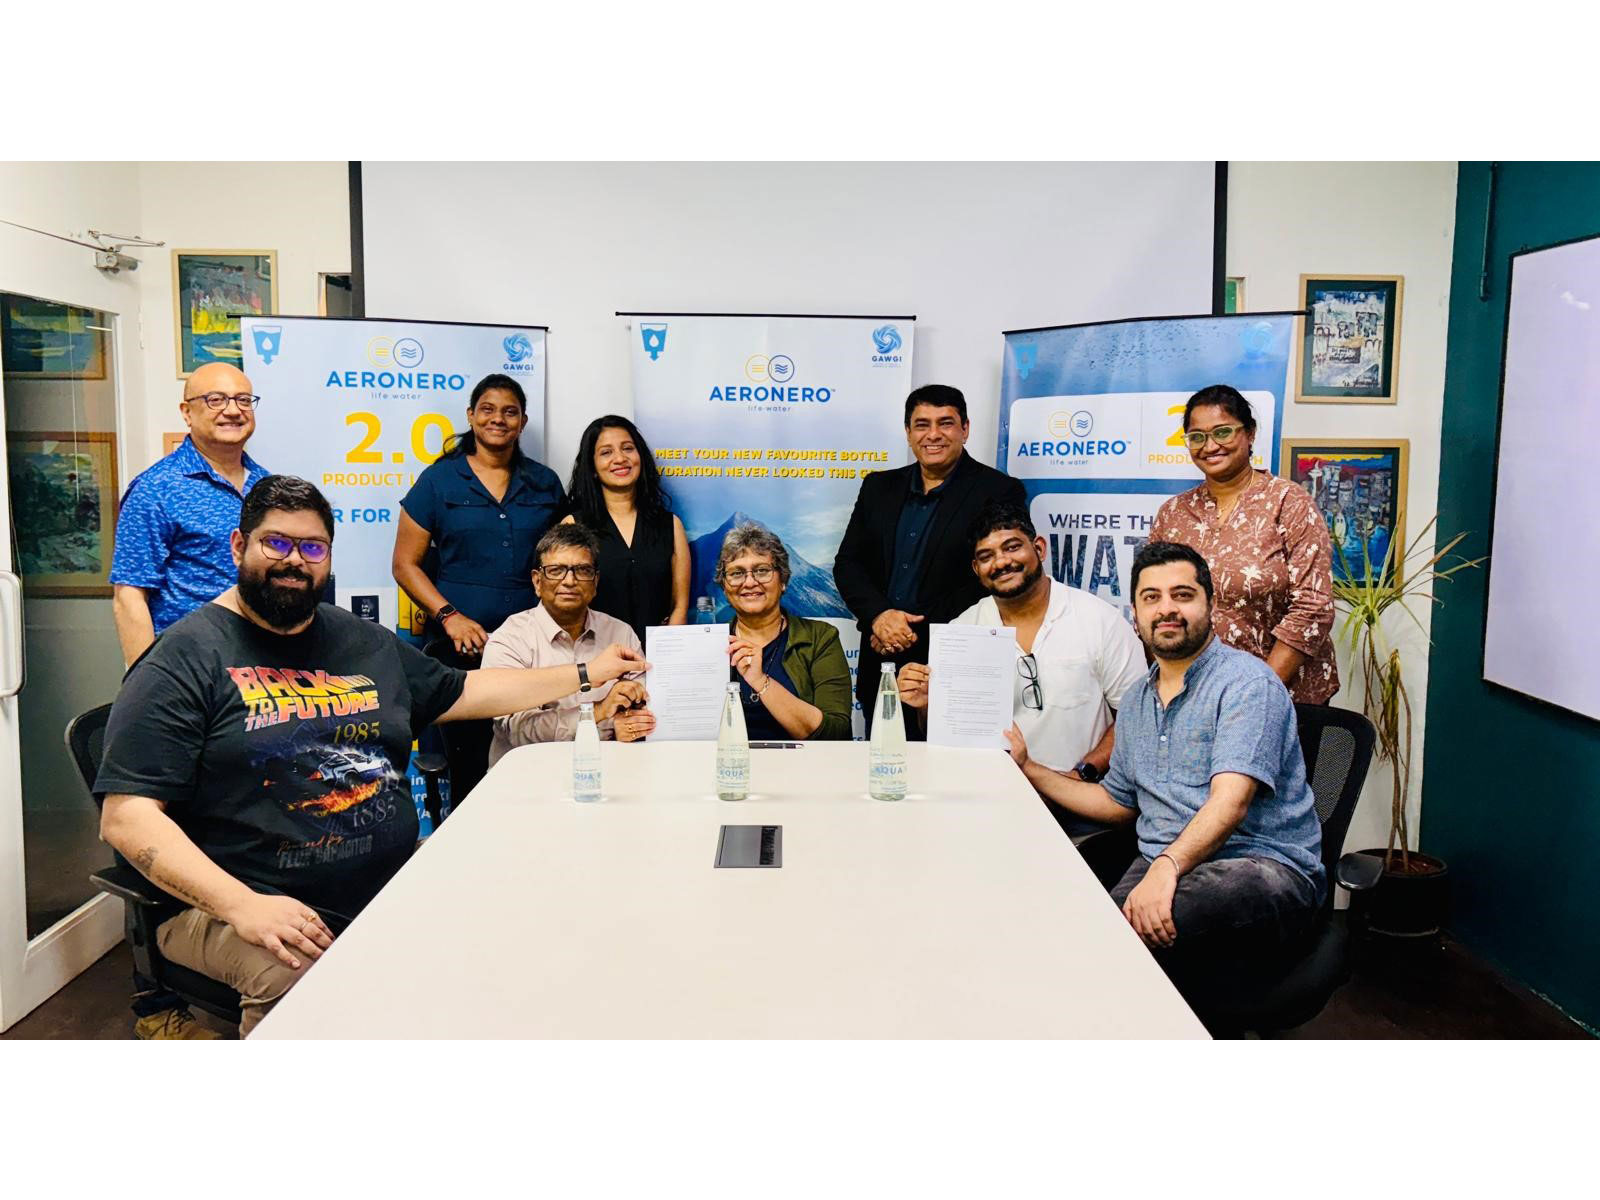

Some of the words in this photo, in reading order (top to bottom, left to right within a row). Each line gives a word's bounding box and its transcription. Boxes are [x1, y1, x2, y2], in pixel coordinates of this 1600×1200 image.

[503, 363, 534, 371] GAWGI
[872, 355, 902, 363] GAWGI
[326, 371, 465, 390] AERONERO
[371, 391, 388, 399] life
[392, 392, 422, 400] water
[709, 386, 831, 402] AERONERO
[748, 404, 763, 412] life
[345, 411, 456, 465] 2.0
[655, 449, 689, 459] MEET
[693, 449, 730, 460] YOUR
[733, 450, 763, 460] NEW
[767, 449, 837, 461] FAVOURITE
[840, 450, 888, 462] BOTTLE
[1017, 439, 1127, 457] AERONERO
[322, 472, 403, 486] PRODUCT
[656, 466, 723, 477] YDRATION
[726, 467, 769, 477] NEVER
[772, 467, 825, 478] LOOKED
[828, 468, 857, 479] THIS
[351, 509, 391, 523] FOR
[1048, 513, 1121, 530] WHERE
[1127, 515, 1154, 531] TH
[1049, 533, 1150, 597] WAT
[226, 666, 375, 702] BACK
[245, 698, 275, 716] TO
[277, 690, 380, 724] FUTURE
[244, 711, 279, 732] THE
[333, 721, 381, 745] 1985
